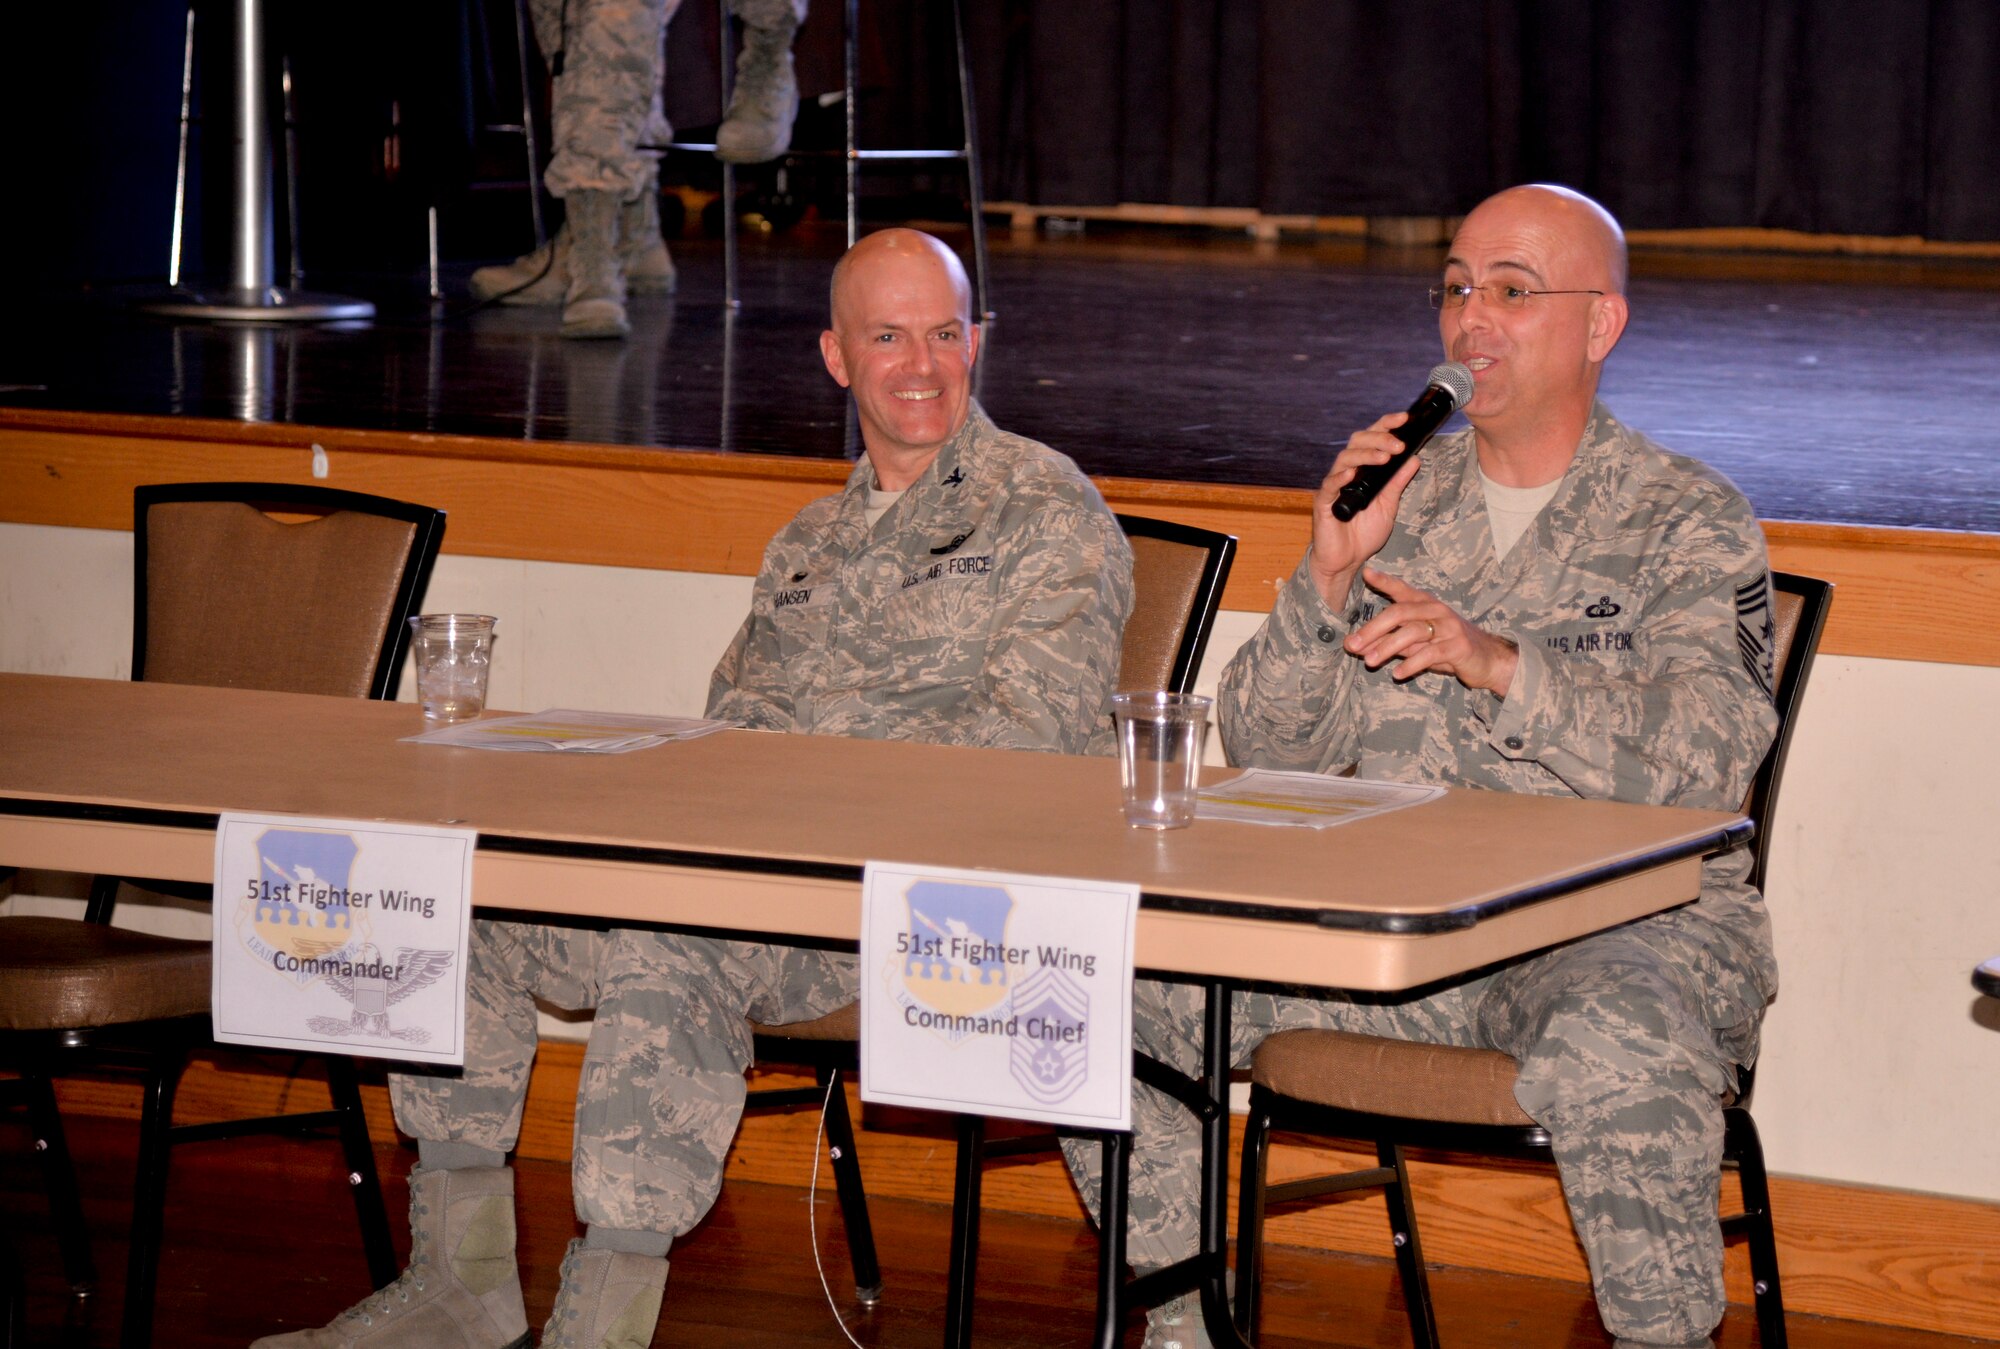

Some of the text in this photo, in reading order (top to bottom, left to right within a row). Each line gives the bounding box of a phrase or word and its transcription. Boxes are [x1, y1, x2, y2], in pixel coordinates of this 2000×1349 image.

[926, 563, 942, 580] AIR
[949, 556, 990, 574] FORCE
[1575, 634, 1601, 652] AIR
[1605, 632, 1633, 651] FOR
[247, 879, 436, 919] 51st Fighter Wing
[273, 950, 404, 980] Commander
[896, 932, 1097, 977] 51st Fighter Wing
[904, 1005, 1018, 1037] Command
[1026, 1018, 1085, 1043] Chief
